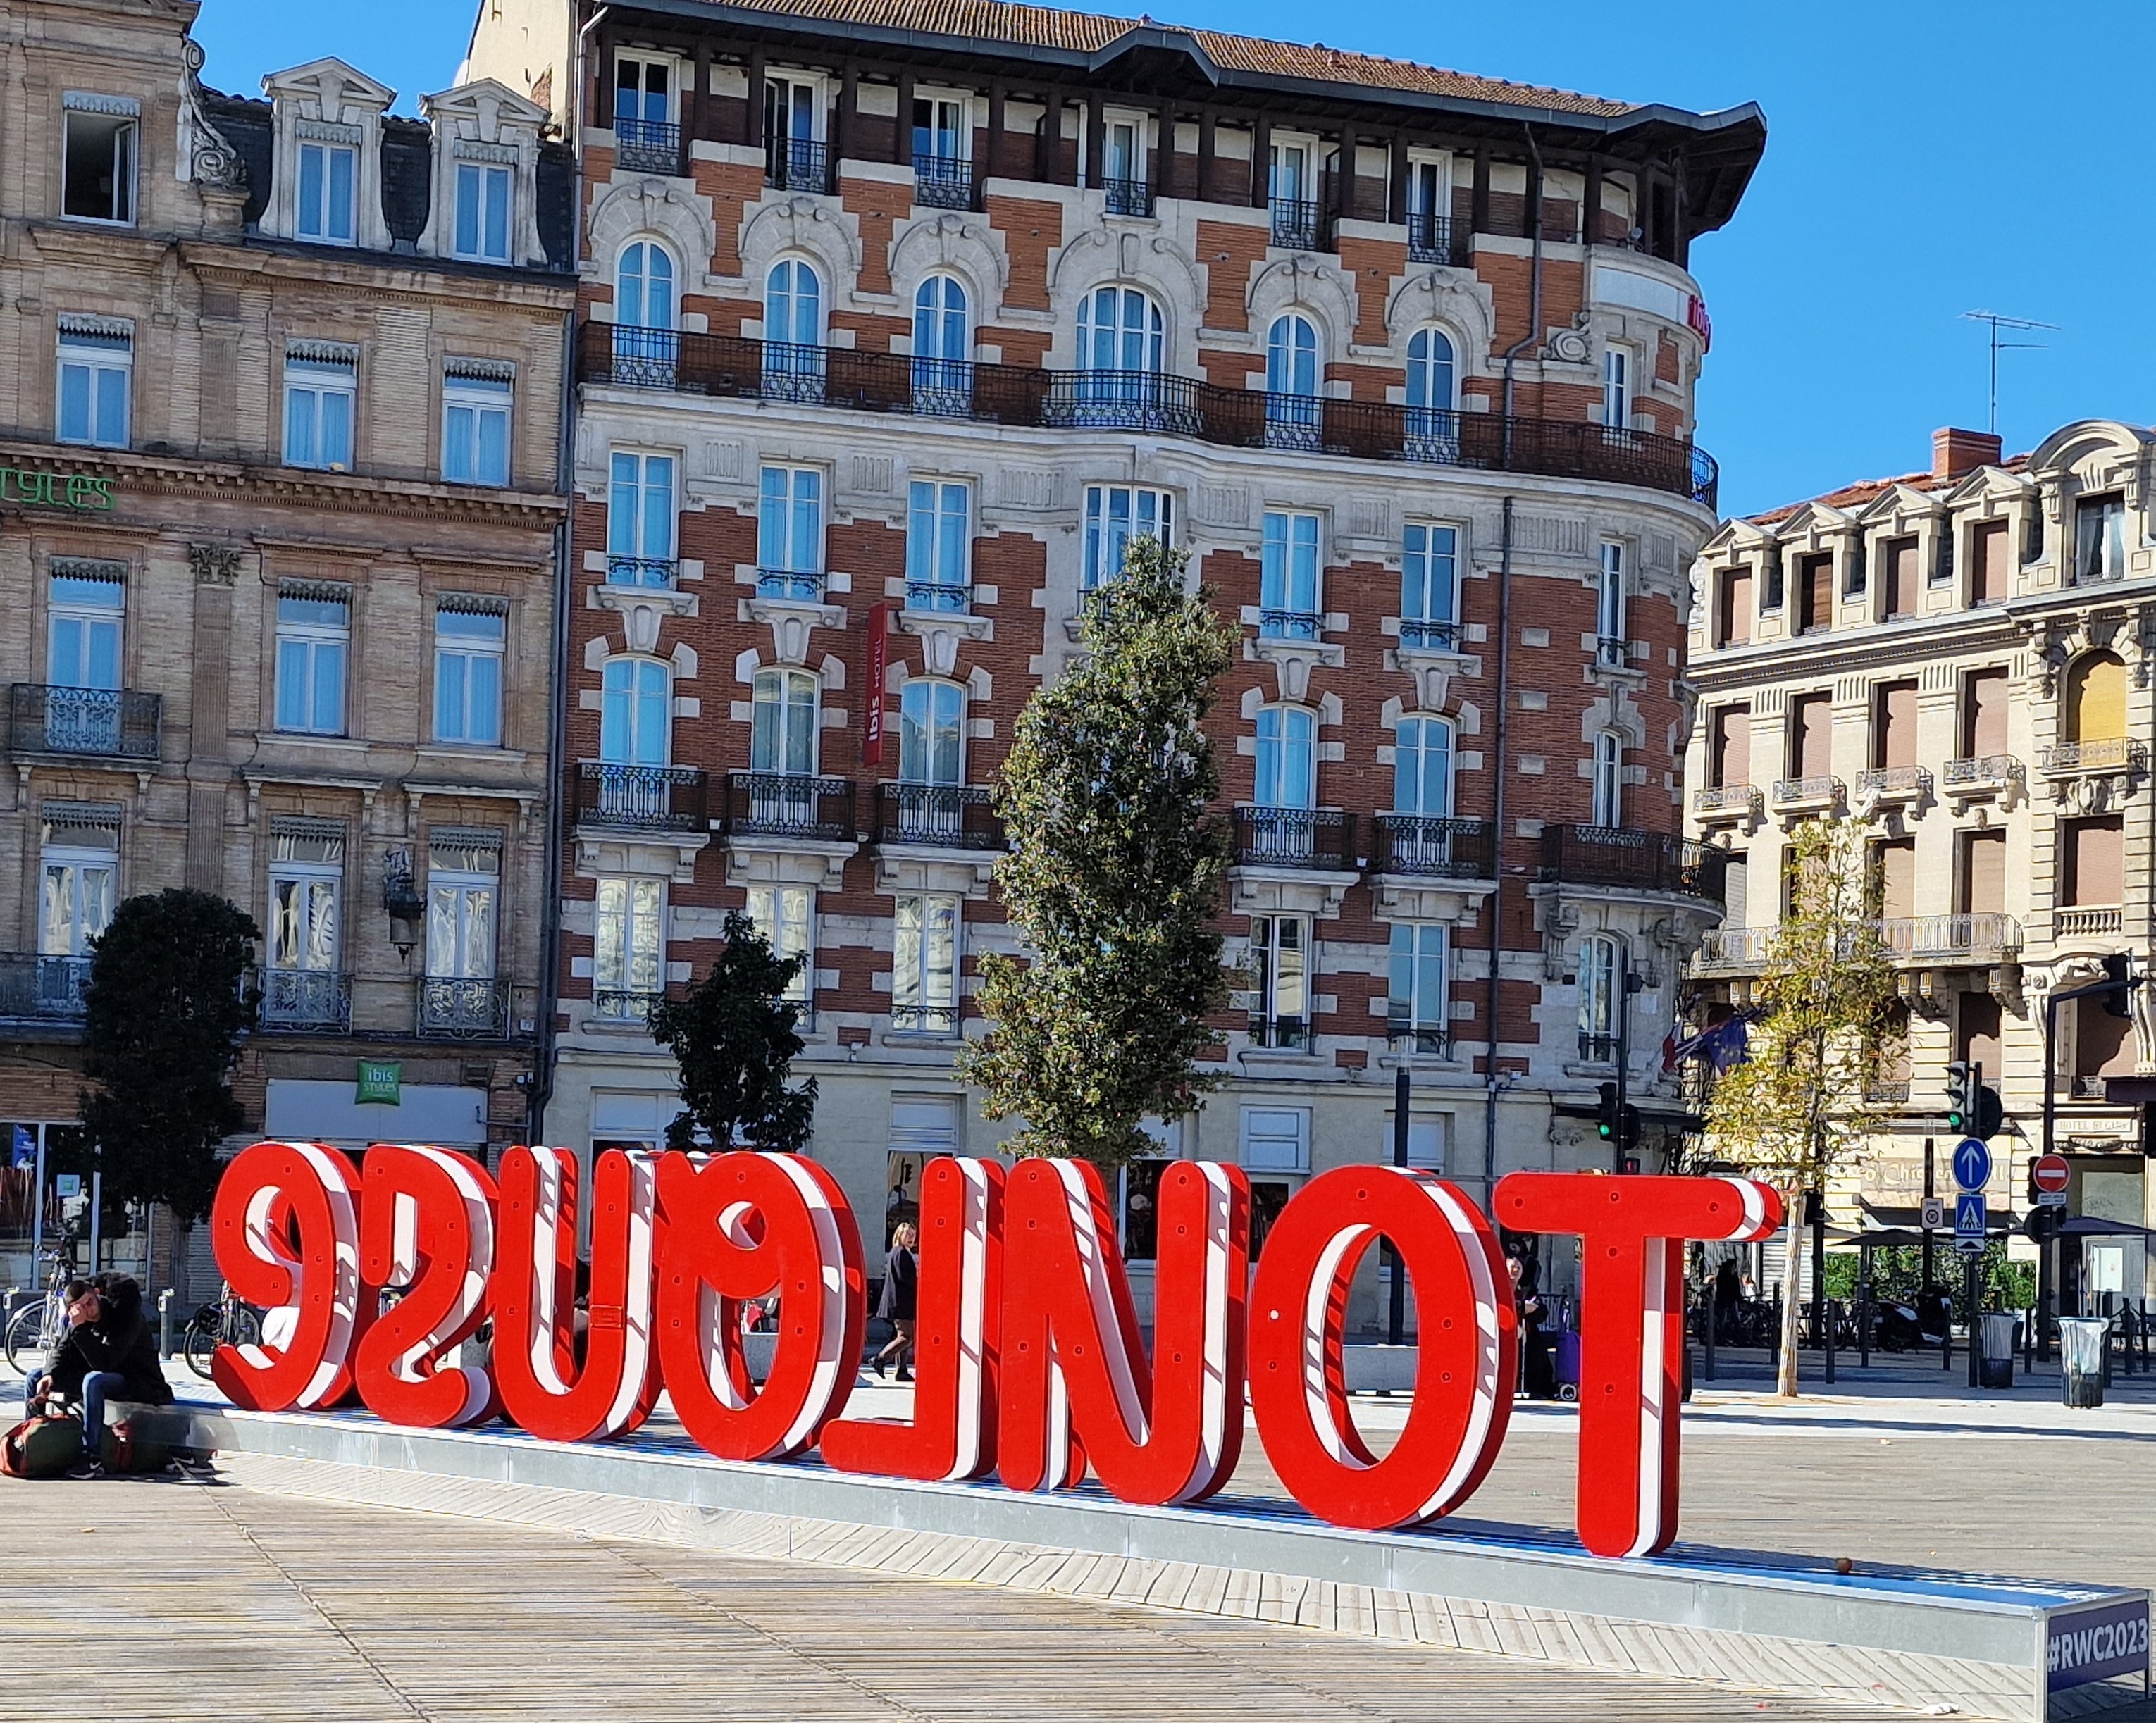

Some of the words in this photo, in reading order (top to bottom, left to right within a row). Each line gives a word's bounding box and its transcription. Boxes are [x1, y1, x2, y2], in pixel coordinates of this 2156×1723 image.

[368, 1067, 393, 1082] ibis
[1883, 1162, 1954, 1185] Chicen
[2047, 1617, 2148, 1673] #RWC2023
